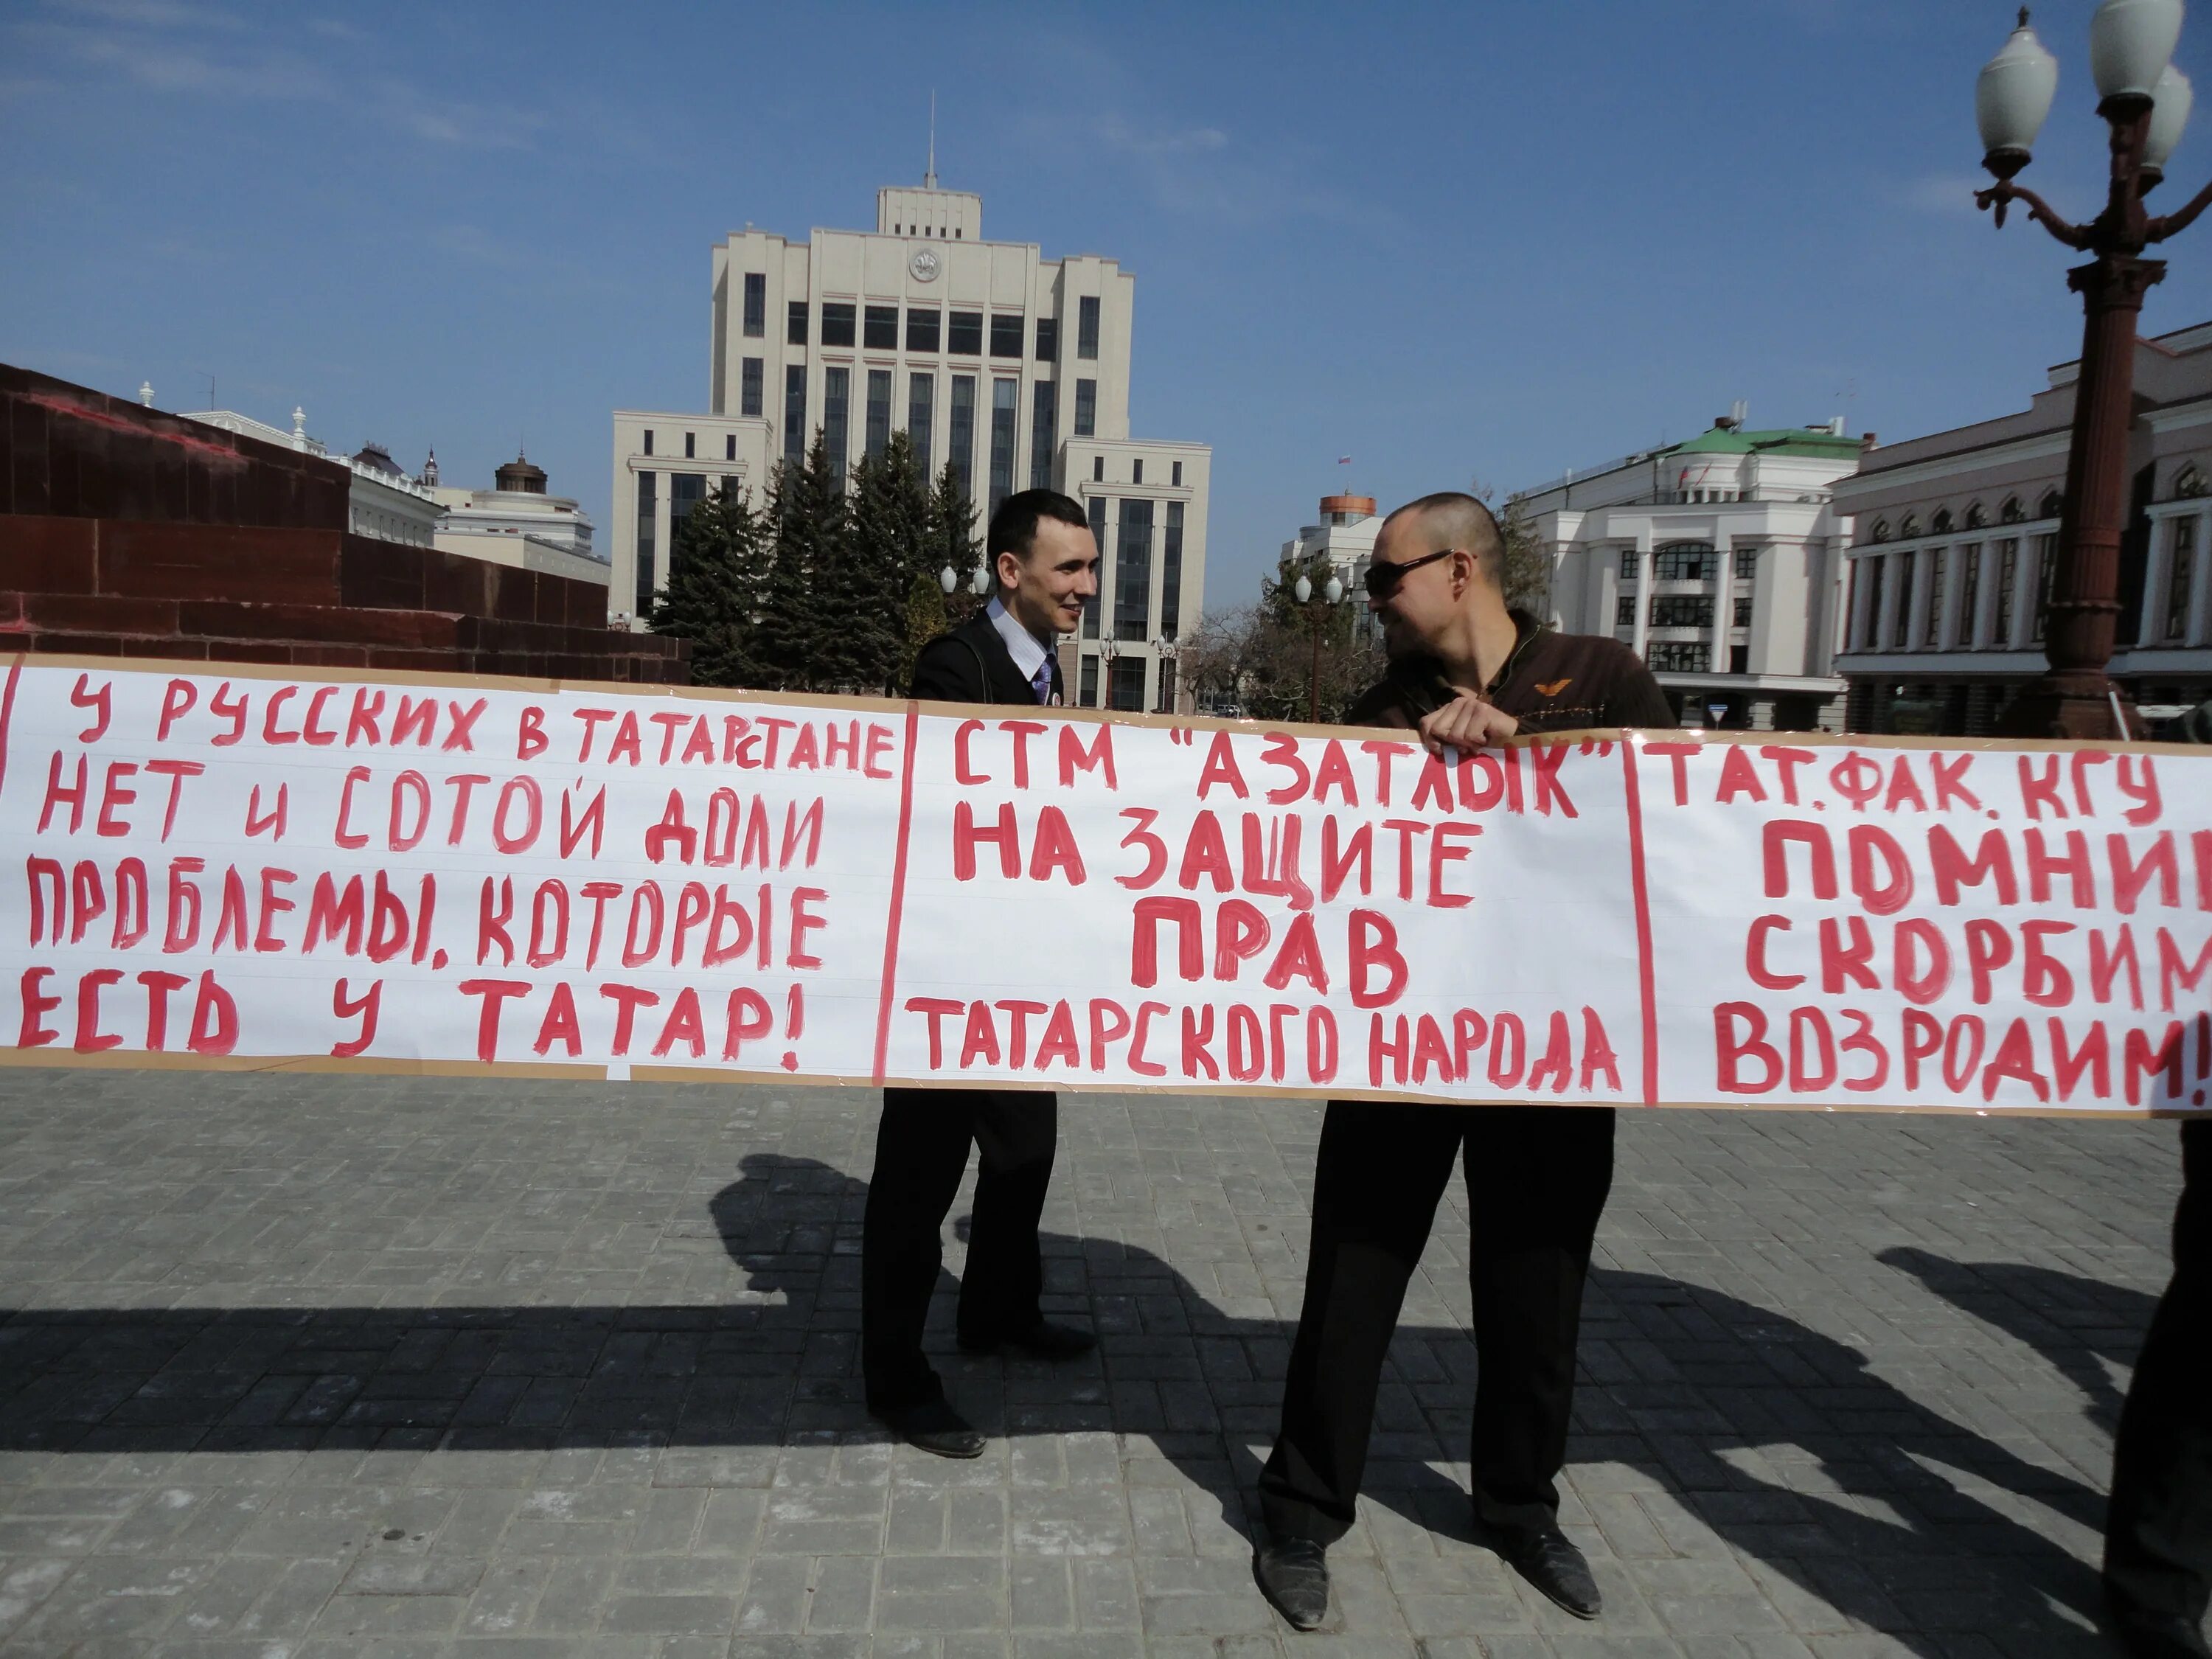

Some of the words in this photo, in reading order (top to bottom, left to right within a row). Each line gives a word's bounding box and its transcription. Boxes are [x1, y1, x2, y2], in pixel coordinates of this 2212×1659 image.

[71, 674, 111, 743] У
[157, 678, 487, 751] РУССКИХ
[517, 706, 549, 760] В
[573, 708, 895, 779] ТАТАРСТАНЕ
[954, 719, 1119, 790] СТМ
[37, 751, 206, 842] НЕТ
[335, 765, 606, 860] СОТОЙ
[644, 787, 824, 873] ДОЛИ
[2018, 748, 2163, 827] КГУ
[953, 801, 1088, 886] НА
[1114, 807, 1484, 911] ЗАЩИТЕ
[1762, 819, 2212, 915] ПОМНИ
[477, 873, 830, 971] КОТОРЫЕ
[1131, 896, 1409, 1009] ПРАВ
[15, 967, 240, 1060] ЕСТЬ
[330, 977, 383, 1059] У
[458, 979, 805, 1072] ТАТАР!
[905, 997, 1339, 1084] ТАТАРСКОГО
[1368, 1005, 1622, 1093] НАРОДА
[1713, 1001, 2212, 1107] ВОЗРОДИМ!
